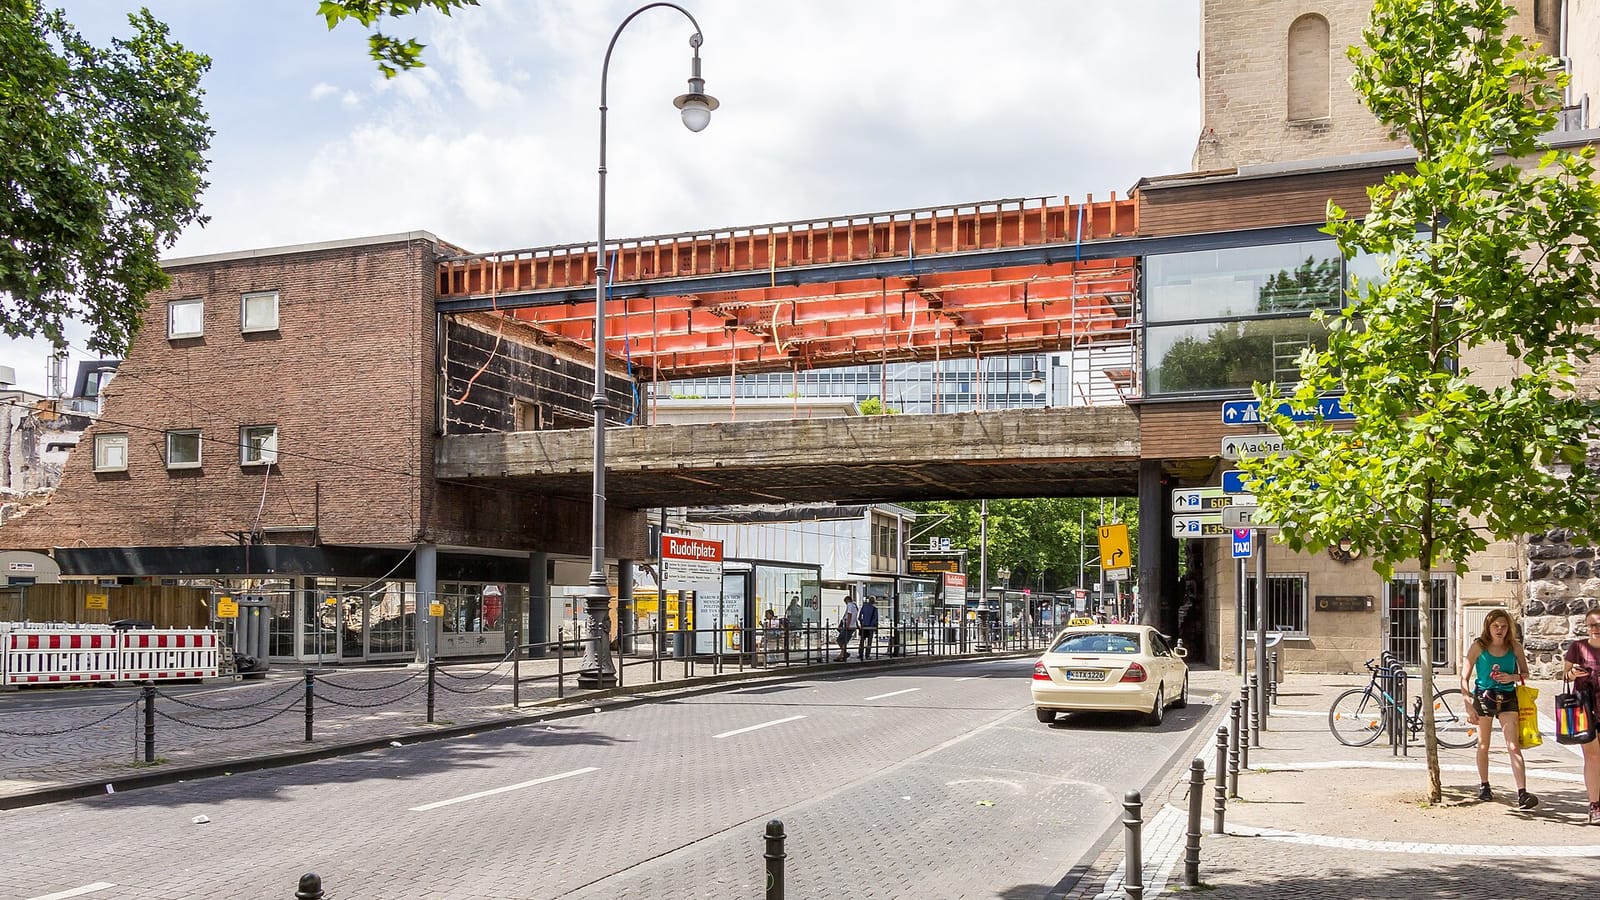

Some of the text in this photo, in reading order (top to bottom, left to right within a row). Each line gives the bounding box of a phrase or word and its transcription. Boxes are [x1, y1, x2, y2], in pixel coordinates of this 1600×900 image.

[1101, 528, 1109, 538] U
[670, 539, 716, 560] Rudolfplatz
[1234, 542, 1250, 553] TAXI
